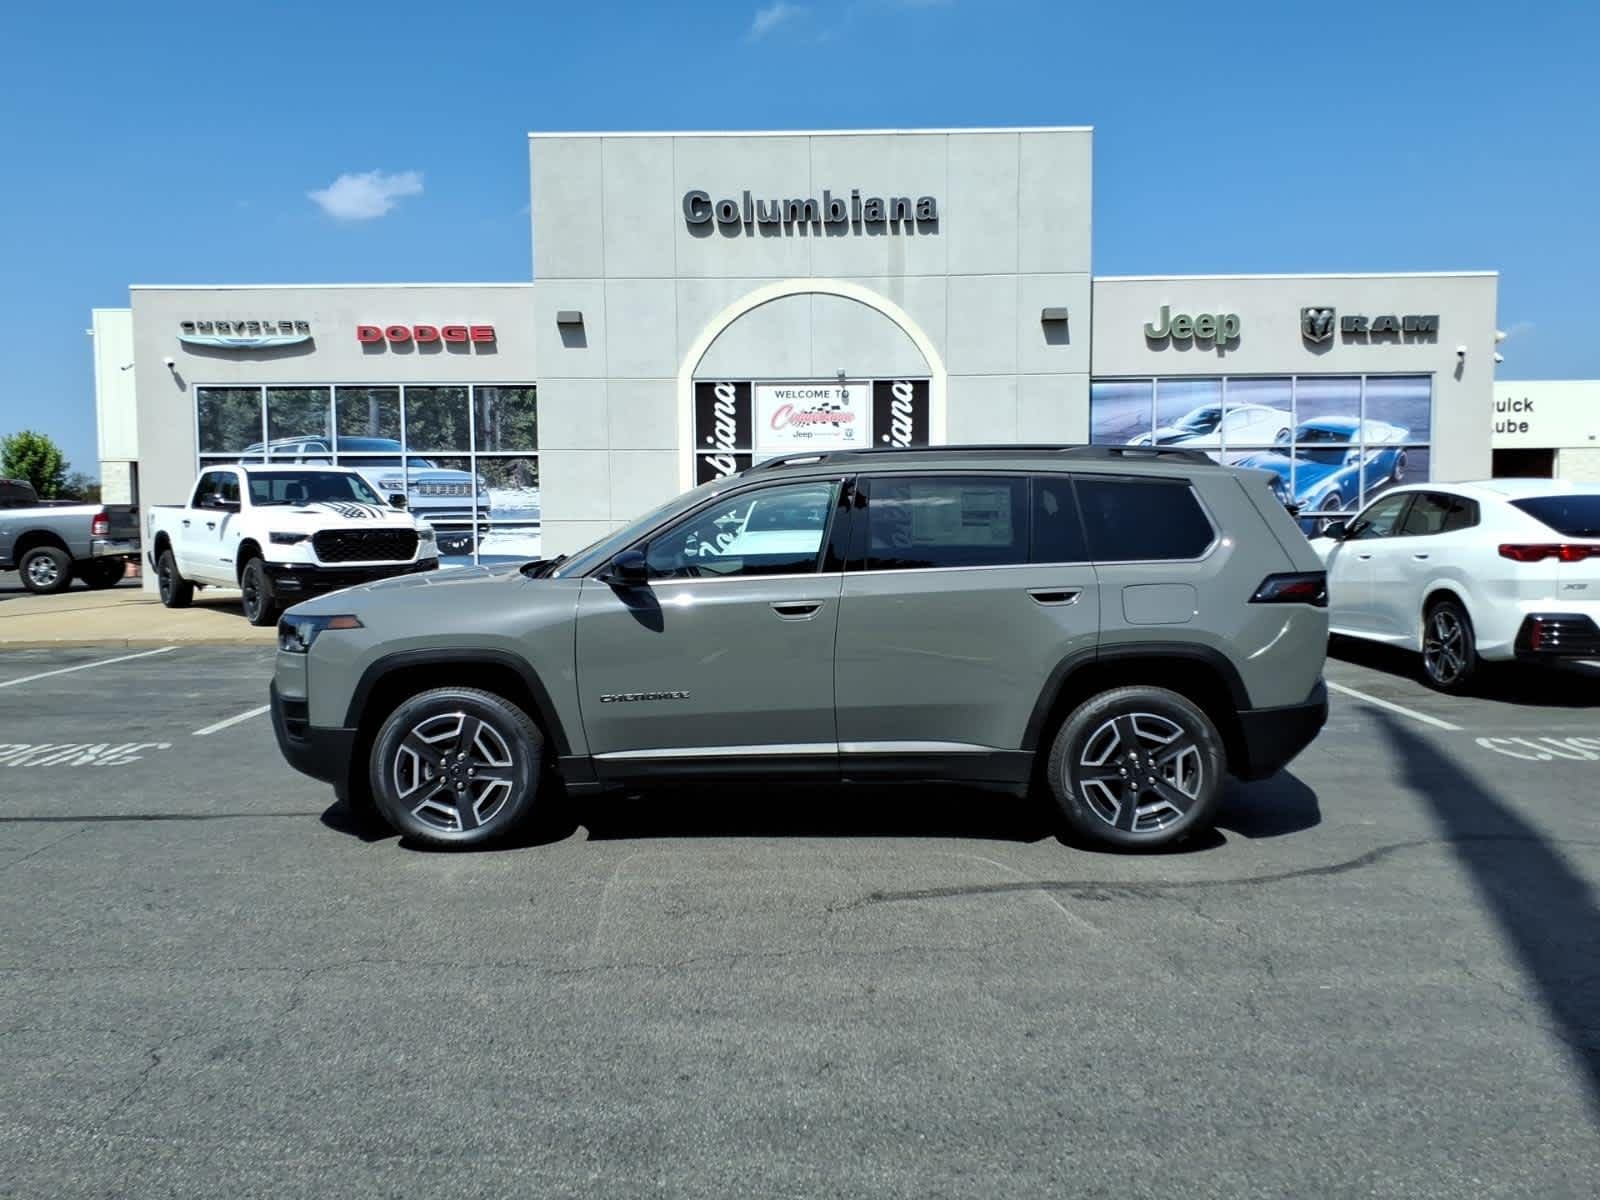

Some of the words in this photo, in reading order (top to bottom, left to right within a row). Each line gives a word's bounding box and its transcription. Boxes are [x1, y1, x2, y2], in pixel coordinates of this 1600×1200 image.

[682, 189, 937, 223] Columbiana
[1144, 305, 1240, 344] Jeep
[1341, 315, 1439, 332] RAM
[356, 325, 496, 342] DODGE
[775, 390, 830, 399] WELCOME
[835, 389, 850, 399] TO
[600, 690, 690, 703] CHEROKEE
